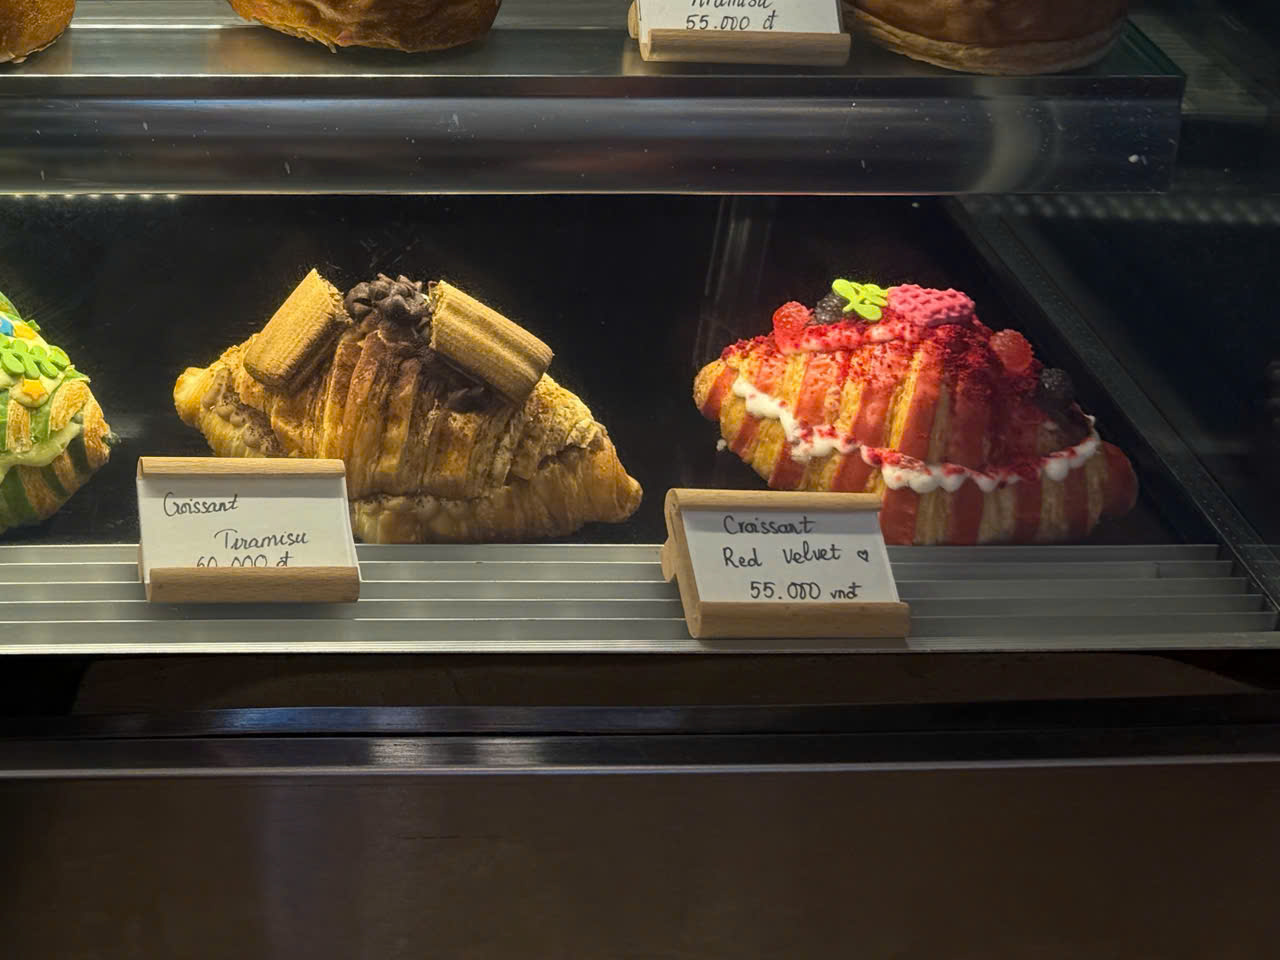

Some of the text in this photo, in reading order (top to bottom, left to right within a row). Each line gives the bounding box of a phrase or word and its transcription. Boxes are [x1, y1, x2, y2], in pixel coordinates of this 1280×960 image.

[163, 491, 239, 517] Croissant
[723, 515, 816, 535] Croissant
[214, 528, 308, 550] Tiramisu
[722, 546, 763, 569] Red
